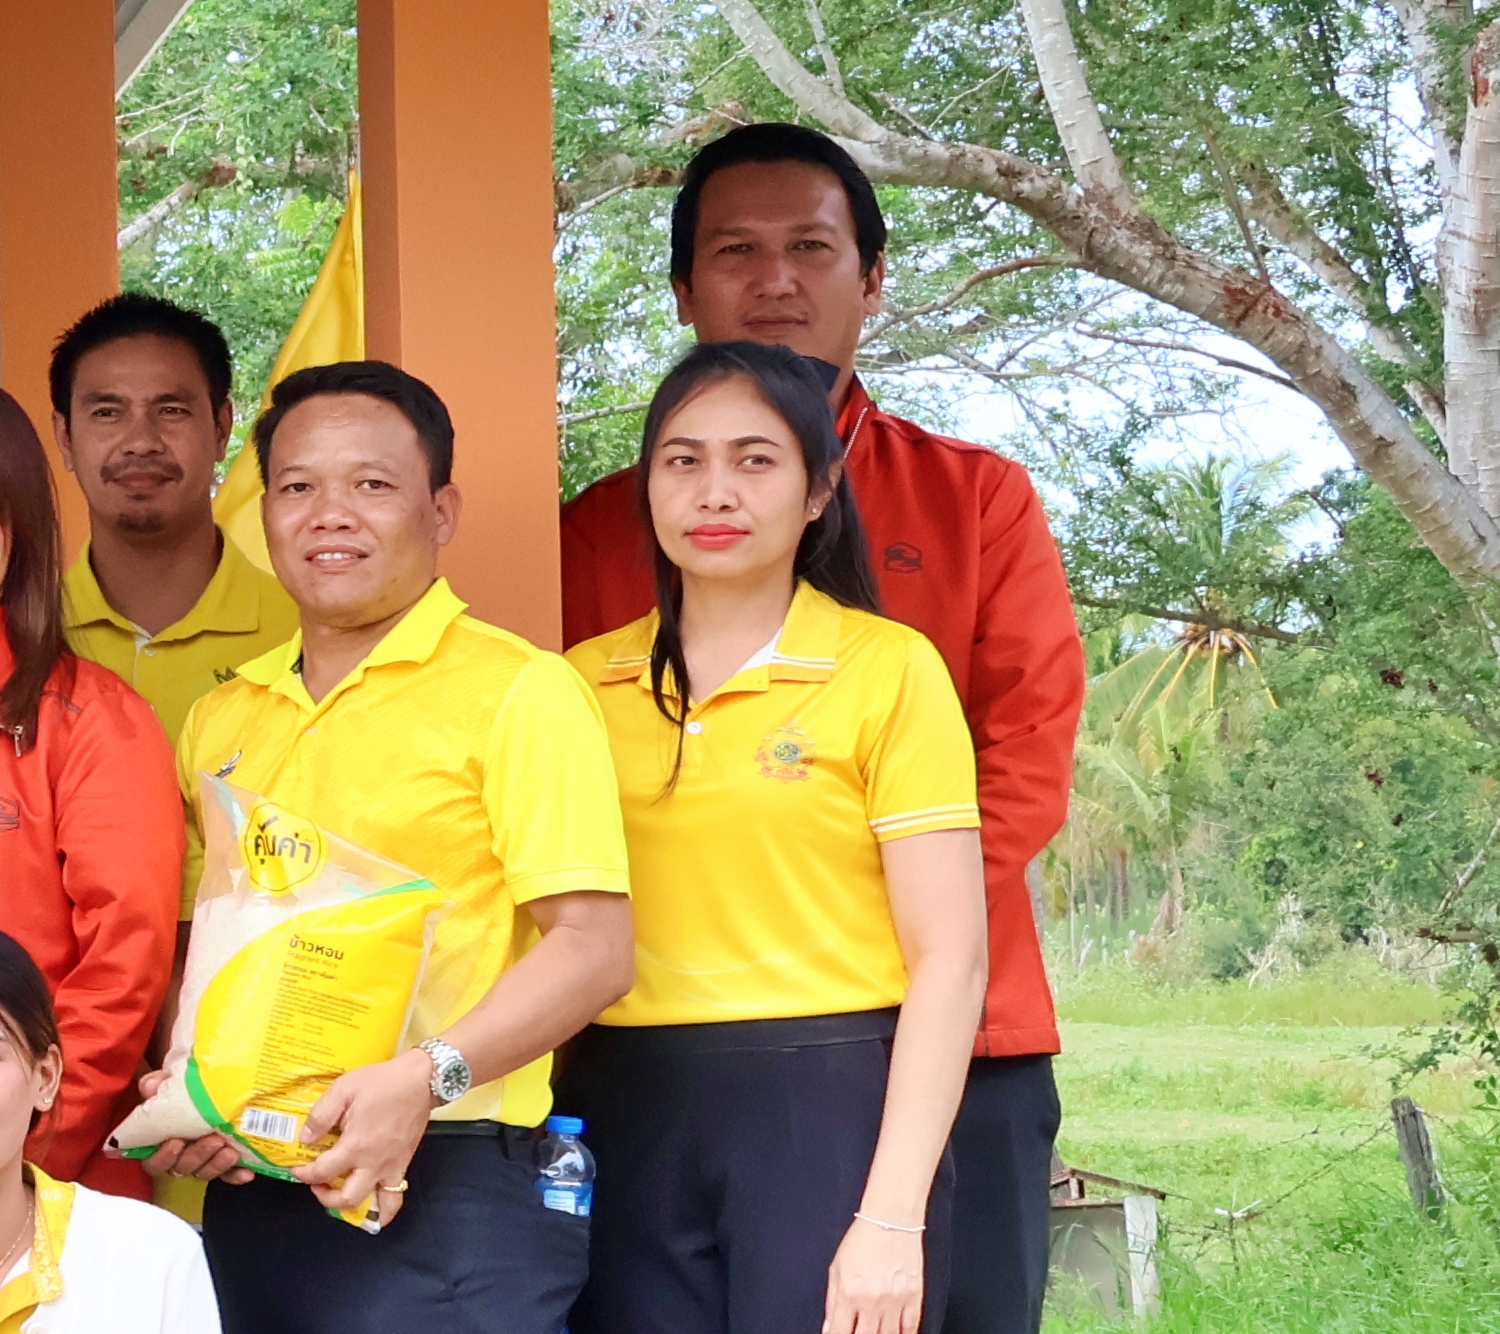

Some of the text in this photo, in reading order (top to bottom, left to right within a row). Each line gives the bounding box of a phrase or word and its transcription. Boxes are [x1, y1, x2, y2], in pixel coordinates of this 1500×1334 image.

[254, 816, 312, 865] คุ้มค่า
[289, 934, 344, 960] ข้าวหอม
